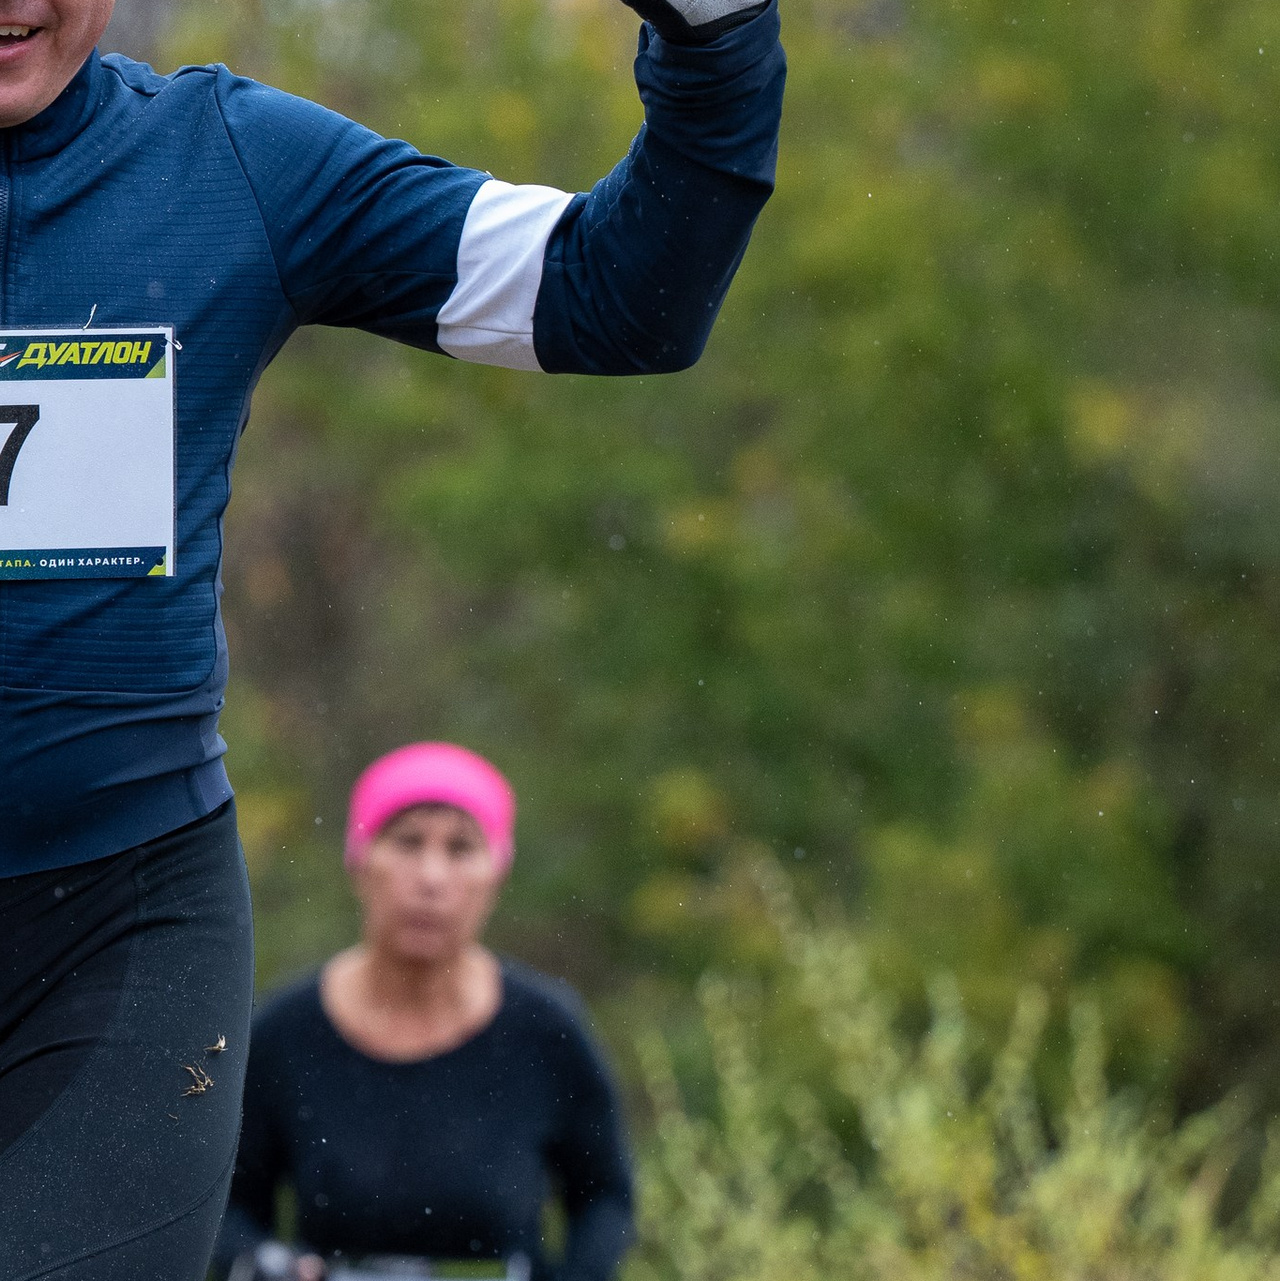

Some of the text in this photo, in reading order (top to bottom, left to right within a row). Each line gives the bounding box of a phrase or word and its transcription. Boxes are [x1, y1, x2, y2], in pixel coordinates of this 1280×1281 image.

[16, 341, 152, 371] ДУАТЛОН
[39, 558, 74, 568] ОДИН
[78, 557, 145, 567] ХАРАКТЕР.
